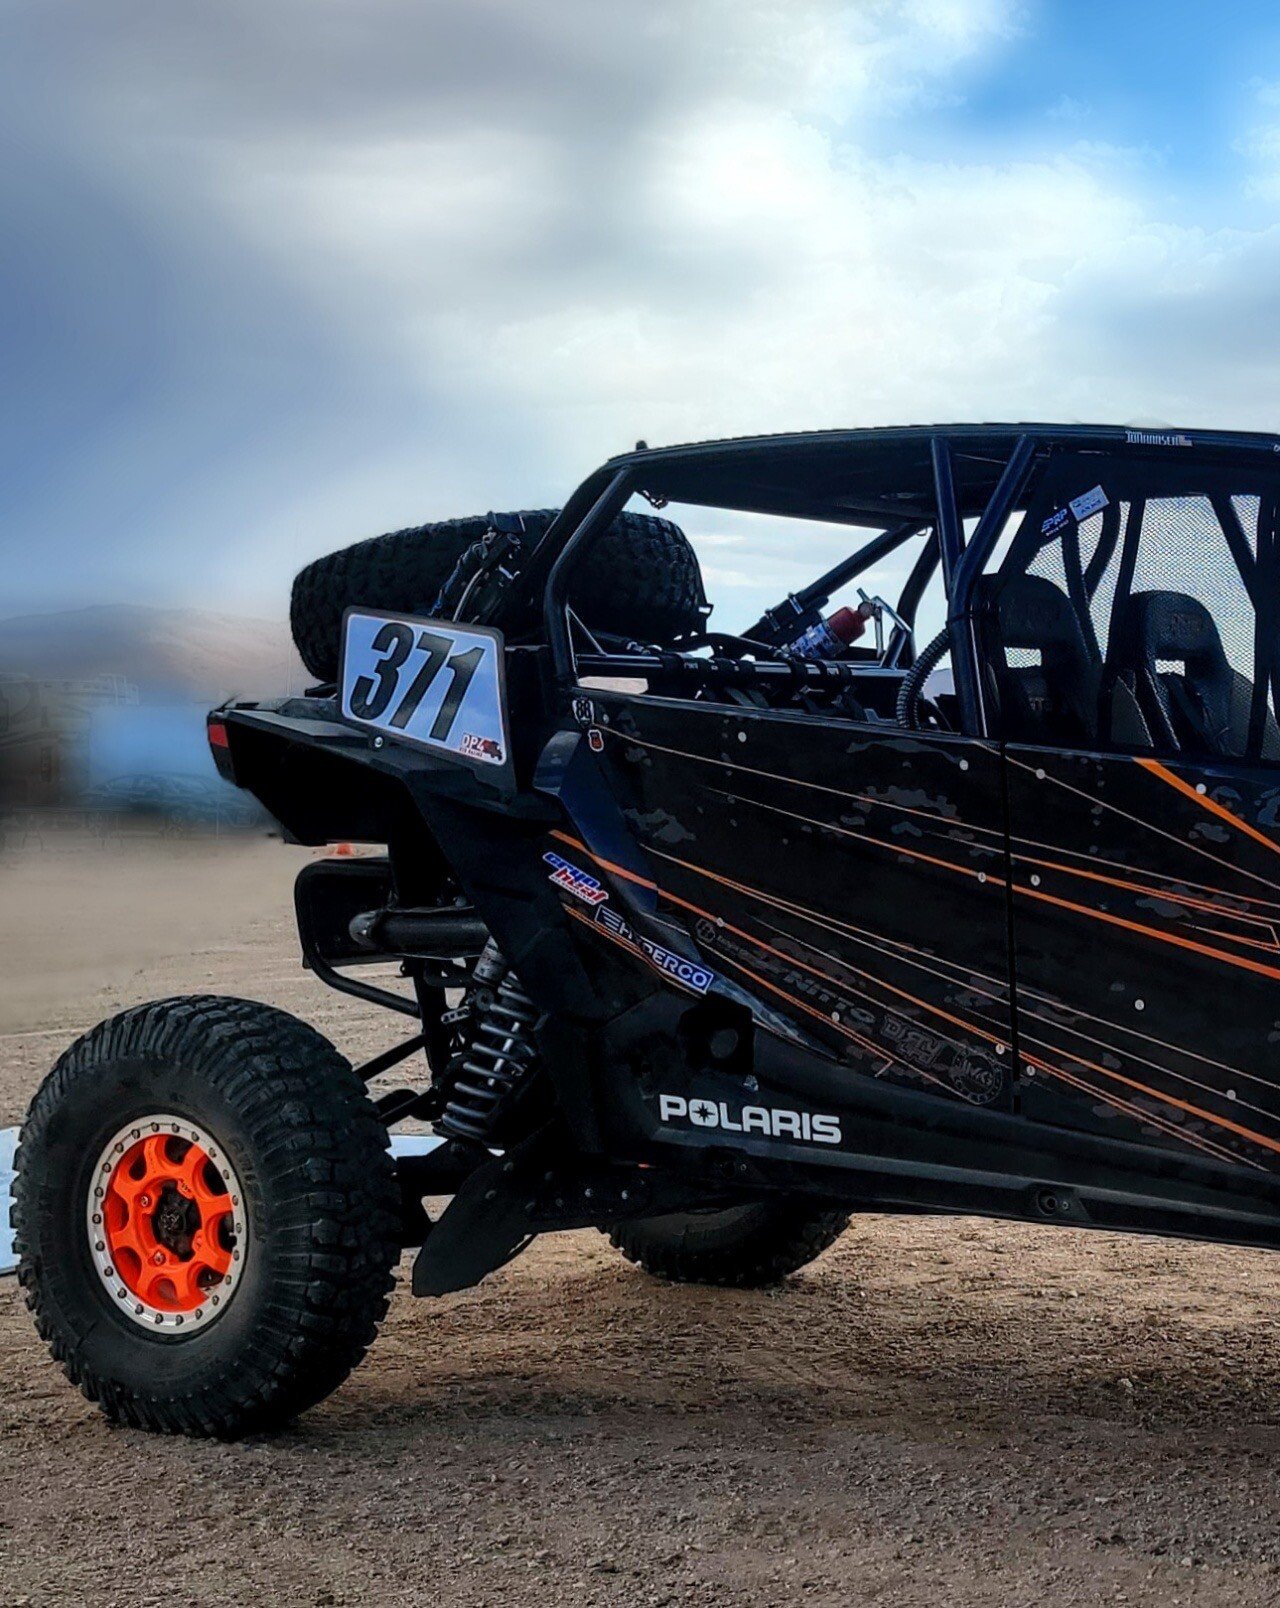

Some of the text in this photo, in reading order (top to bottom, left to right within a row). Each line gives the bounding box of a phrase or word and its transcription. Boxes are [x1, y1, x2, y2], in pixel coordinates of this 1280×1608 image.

[350, 622, 485, 742] 371
[619, 922, 708, 987] HPERCO
[659, 1094, 842, 1144] POLARIS
